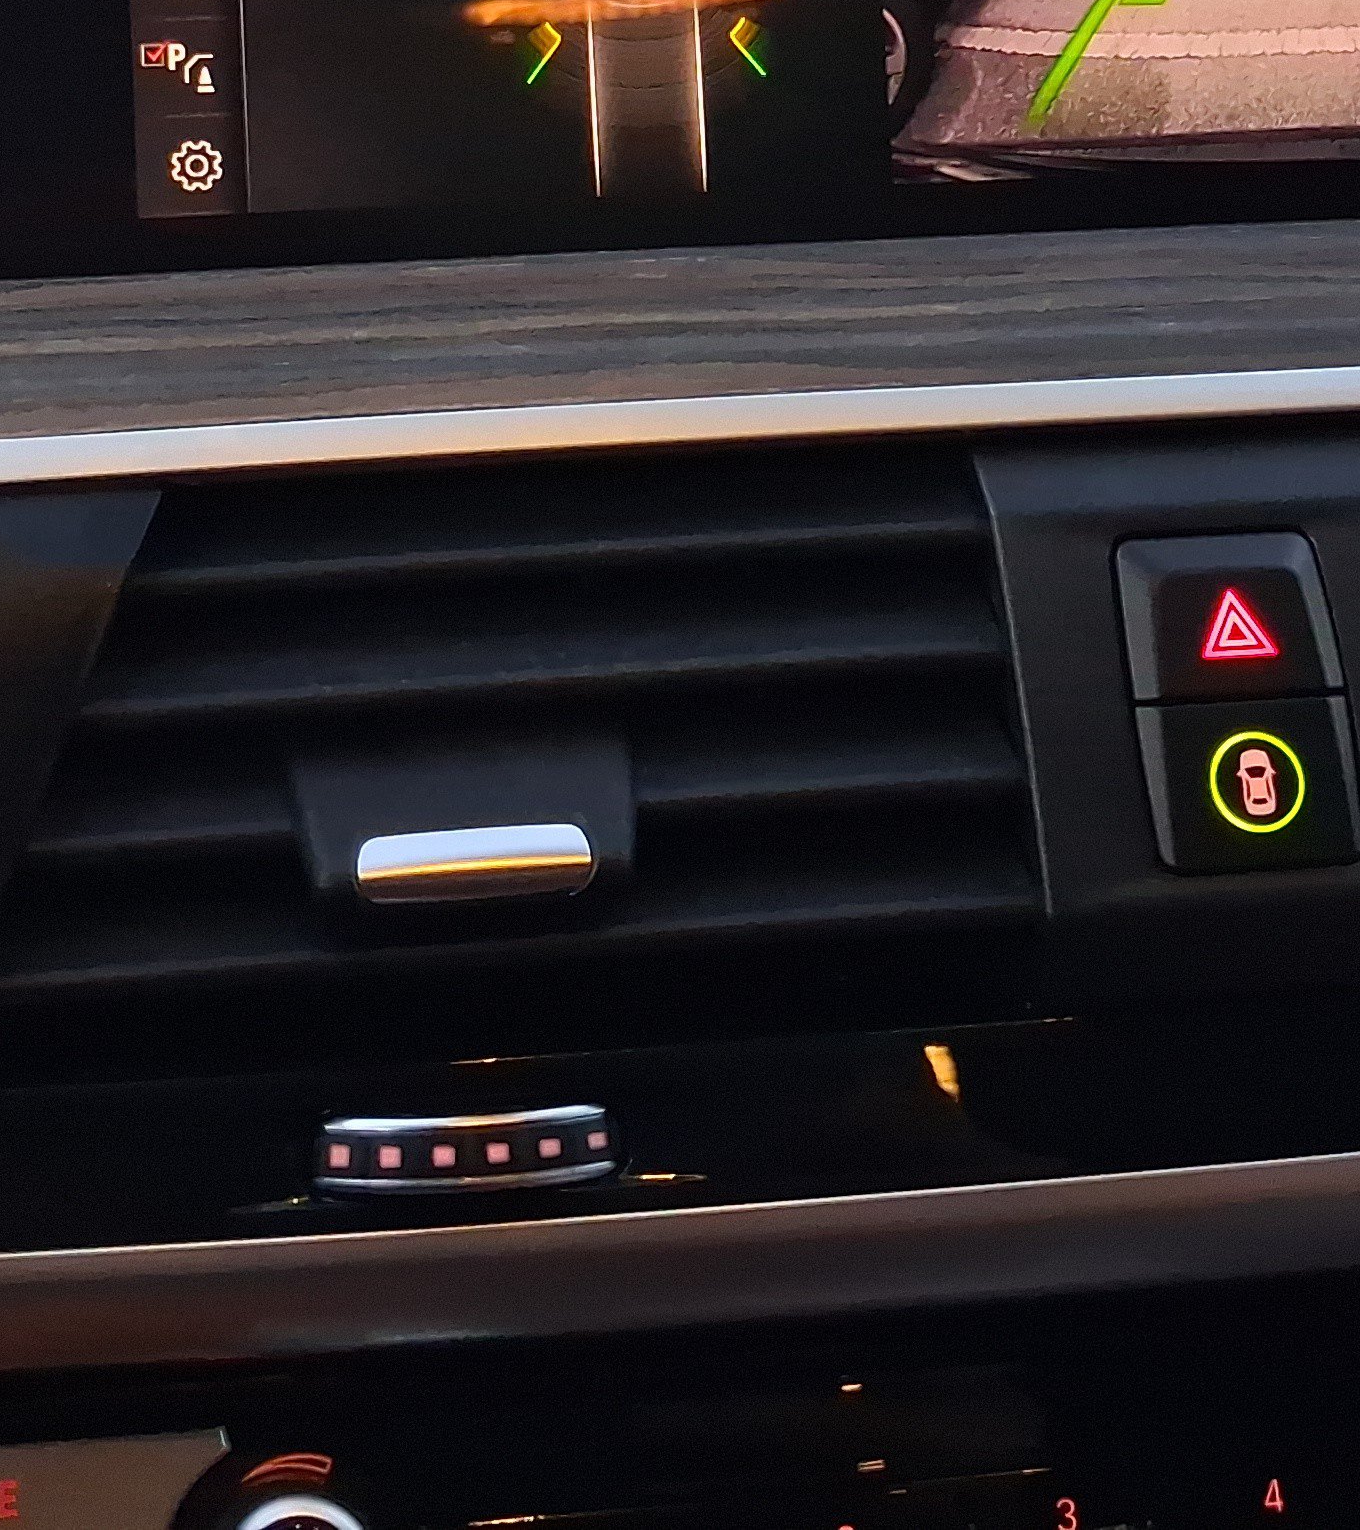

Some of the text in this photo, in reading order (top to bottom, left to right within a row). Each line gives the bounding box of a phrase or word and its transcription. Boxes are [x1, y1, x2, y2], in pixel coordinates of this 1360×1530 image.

[167, 43, 186, 71] P
[1264, 1478, 1284, 1513] 4
[1056, 1497, 1078, 1530] 3
